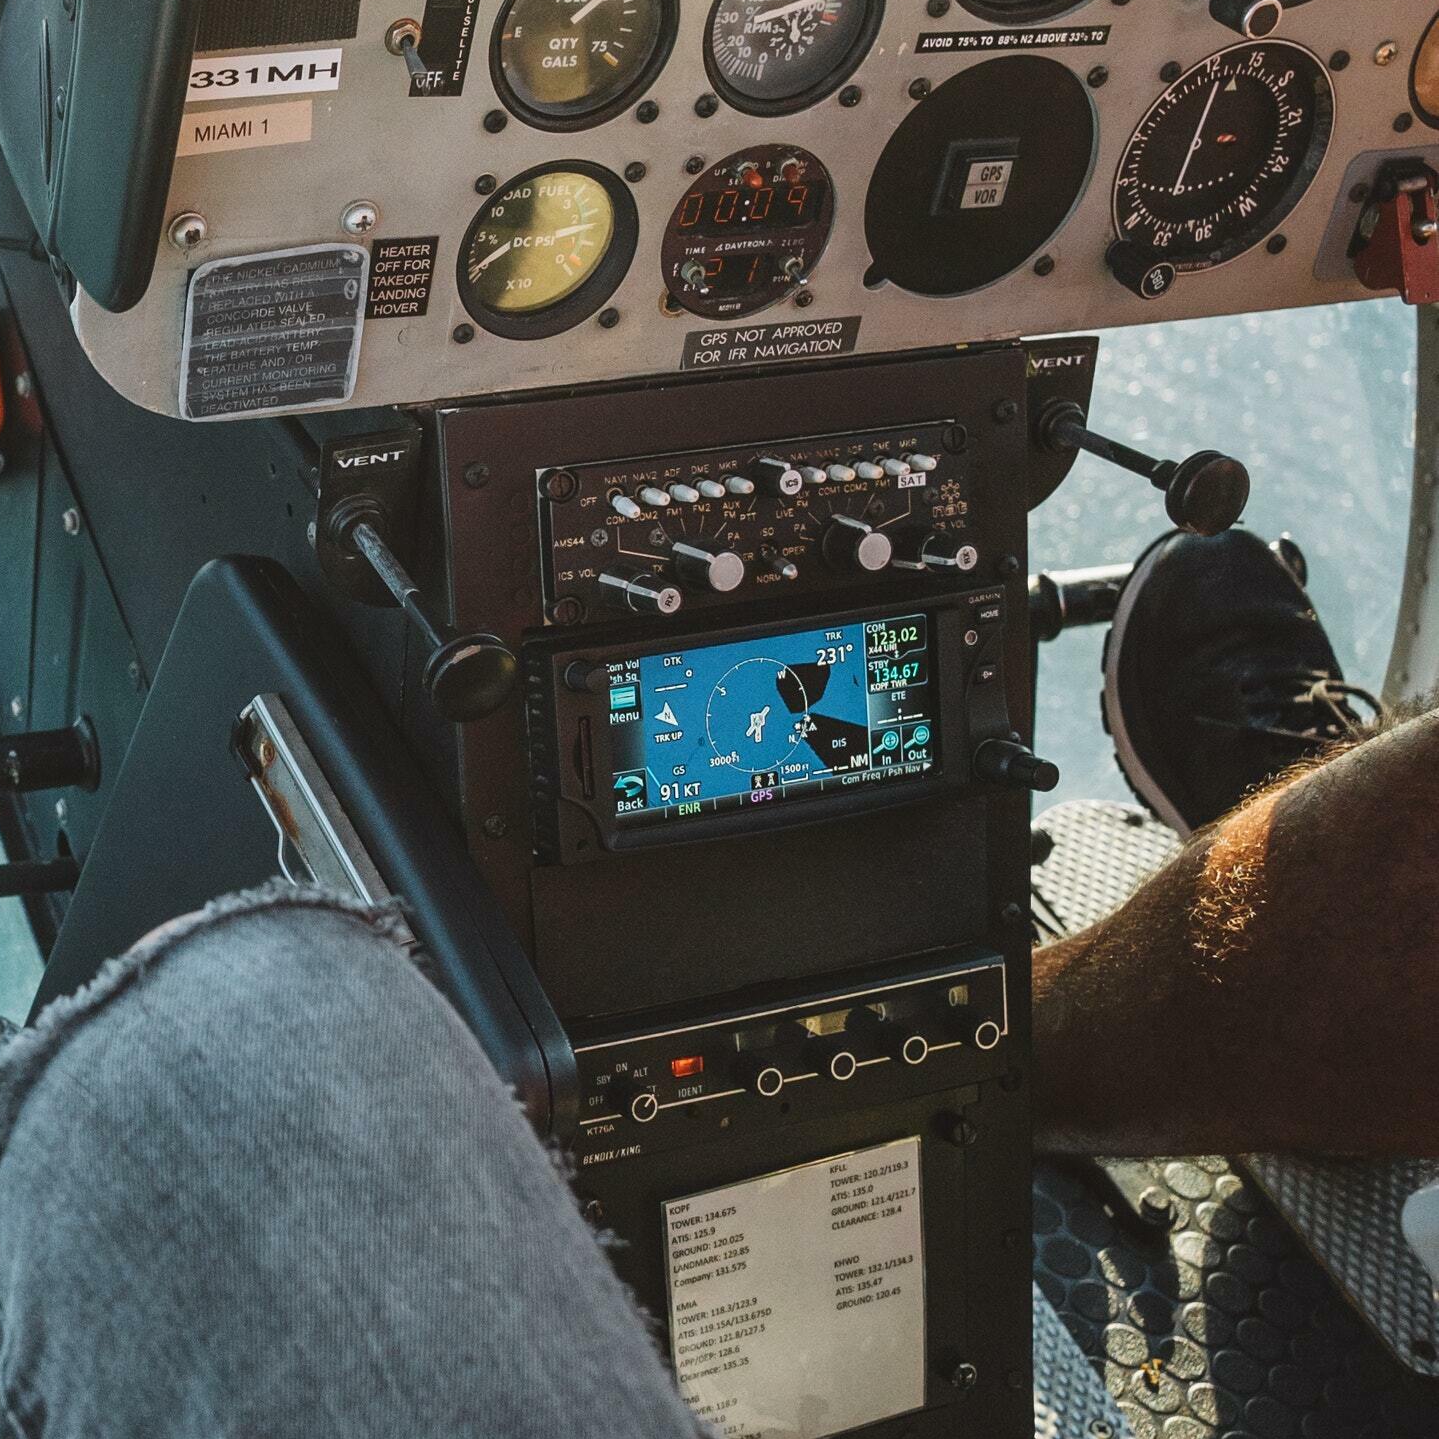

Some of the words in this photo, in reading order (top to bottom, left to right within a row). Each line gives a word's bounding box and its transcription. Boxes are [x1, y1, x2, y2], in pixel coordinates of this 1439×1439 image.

[744, 23, 772, 34] RPM
[549, 38, 579, 50] QTY
[922, 37, 952, 48] AVOID
[958, 36, 977, 47] 75%
[980, 36, 993, 46] TO
[1020, 34, 1034, 44] N2
[1036, 32, 1067, 43] ABOVE
[1069, 32, 1088, 42] 33%
[590, 41, 607, 53] 75
[542, 56, 578, 68] GALS
[190, 62, 338, 88] 331MH
[195, 120, 252, 142] MIAMI
[262, 119, 268, 134] 1
[981, 166, 1003, 182] GPS
[539, 186, 571, 197] FUEL
[974, 189, 997, 204] VOR
[514, 237, 532, 247] DC
[535, 236, 556, 246] PSI
[380, 245, 430, 258] HEATER
[685, 247, 705, 255] TIME
[375, 261, 400, 273] OFF
[404, 259, 430, 271] FOR
[372, 274, 429, 287] TAKEOFF
[371, 288, 426, 301] LANDING
[208, 308, 275, 324] CONCORDE
[279, 301, 312, 315] VALVE
[374, 302, 418, 315] HOVER
[280, 313, 325, 327] SEALED
[701, 333, 727, 346] GPS
[735, 329, 766, 344] NOT
[772, 322, 843, 338] APPROVED
[694, 351, 721, 364] FOR
[729, 348, 746, 360] IFR
[754, 339, 842, 358] NAVIGATION
[1031, 355, 1085, 369] VENT
[338, 451, 404, 468] VENT
[900, 476, 923, 486] SAT
[580, 497, 597, 507] OFF
[579, 568, 595, 578] VOL
[825, 632, 842, 641] TRK
[872, 627, 917, 646] 123.02
[664, 656, 682, 667] DTK
[874, 663, 919, 683] 134.67
[610, 711, 639, 724] Menu
[908, 749, 926, 760] Out
[842, 773, 859, 784] Com
[862, 770, 881, 782] Freq
[888, 766, 902, 777] Psh
[661, 783, 679, 800] 91
[685, 782, 700, 796] KT
[751, 789, 773, 802] GPS
[618, 798, 643, 810] Back
[679, 802, 701, 815] ENR
[678, 1085, 703, 1098] IDENT
